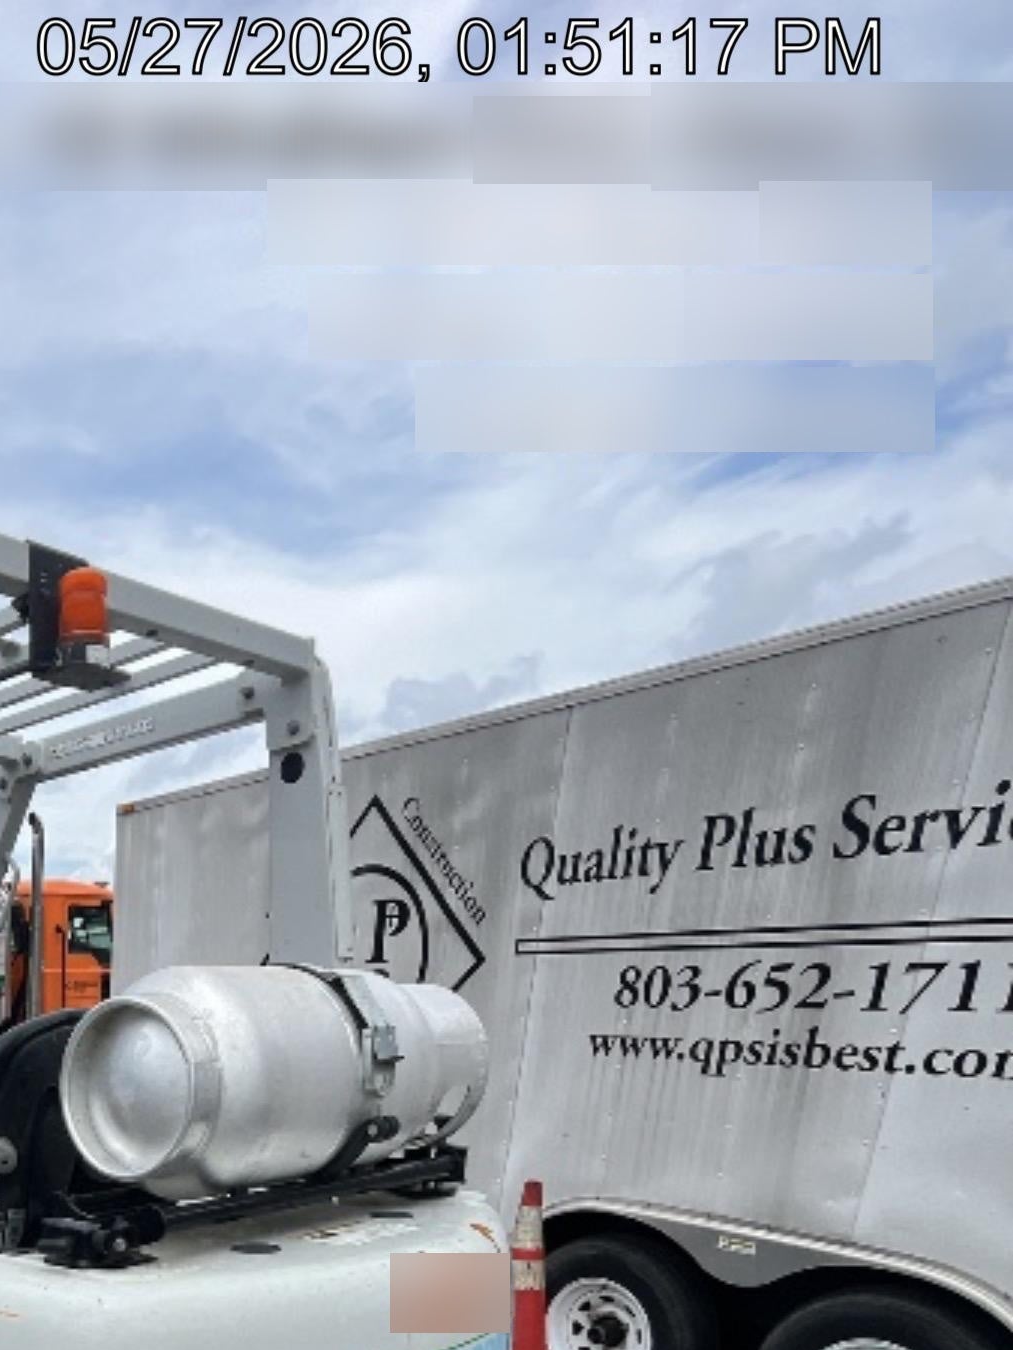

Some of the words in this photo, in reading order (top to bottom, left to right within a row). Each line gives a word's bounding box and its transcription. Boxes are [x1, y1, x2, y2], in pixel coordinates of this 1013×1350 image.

[403, 797, 487, 927] Construction
[520, 826, 683, 901] Quality
[696, 808, 817, 871] Plus
[832, 779, 1013, 860] Servi
